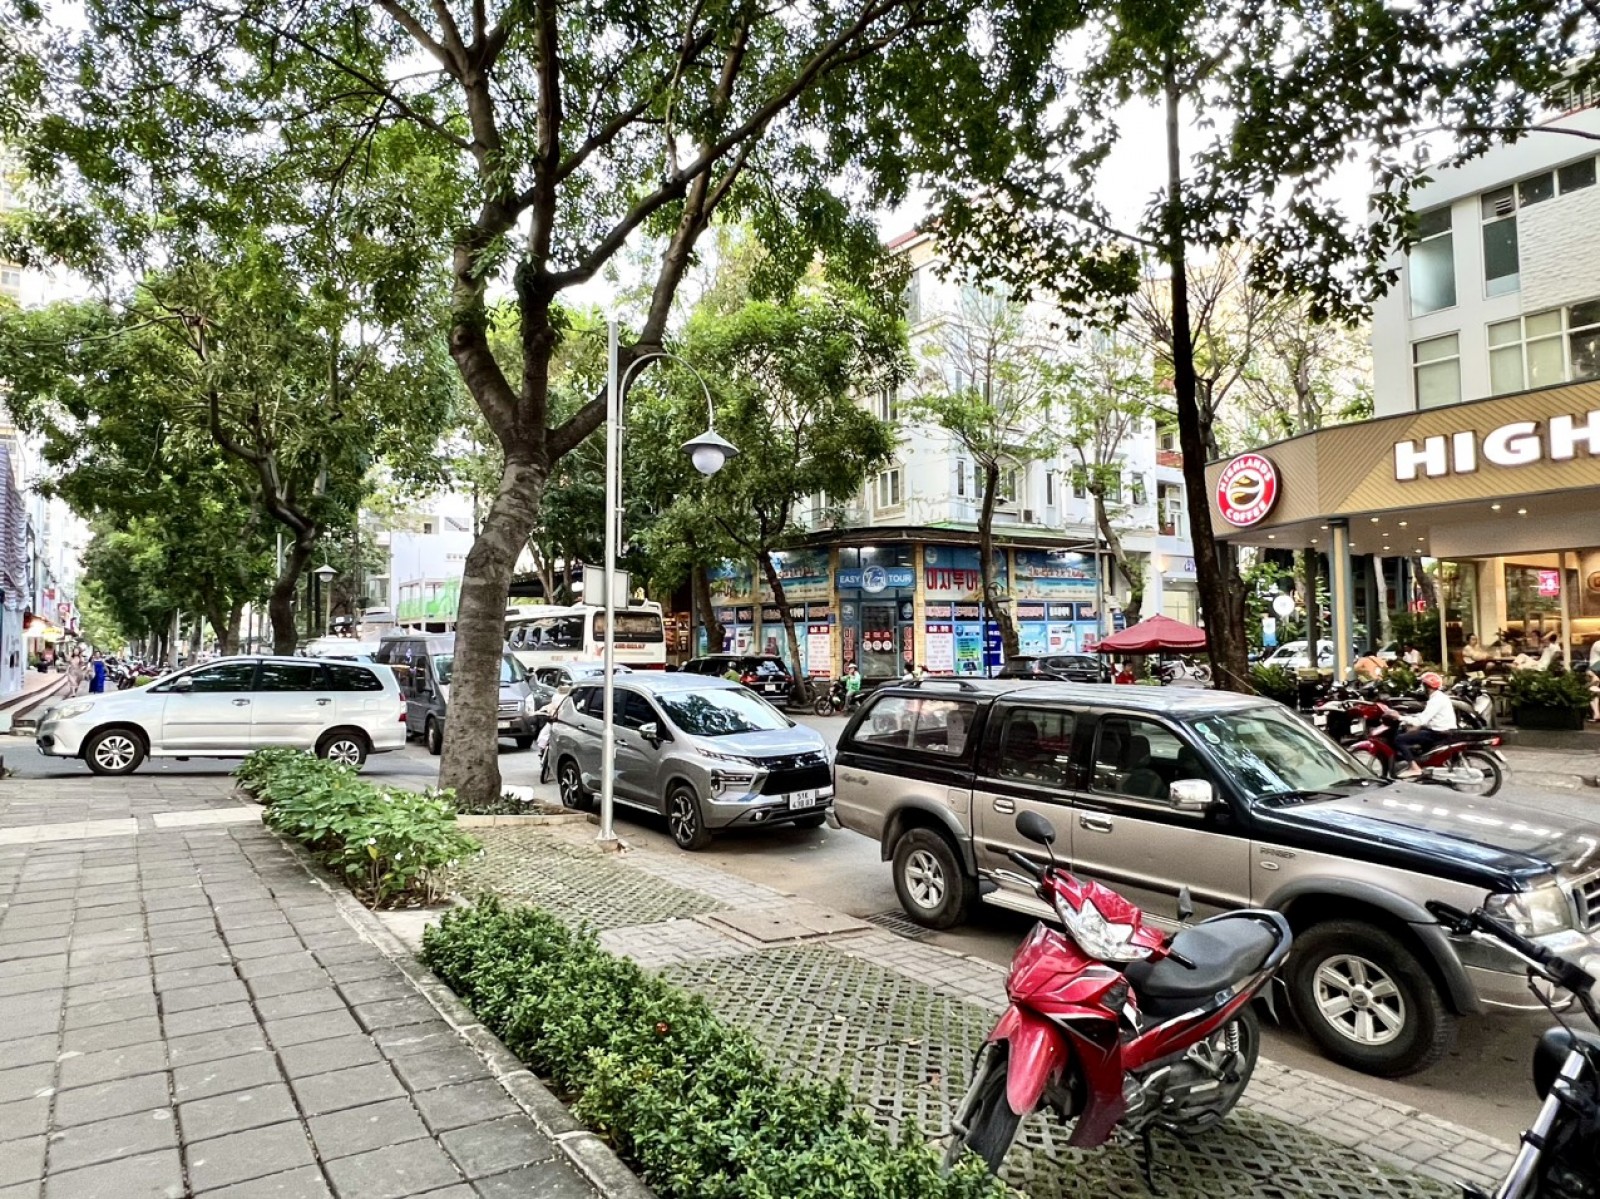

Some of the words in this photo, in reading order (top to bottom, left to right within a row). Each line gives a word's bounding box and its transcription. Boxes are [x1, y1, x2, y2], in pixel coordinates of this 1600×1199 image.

[1394, 410, 1600, 481] HIGH
[1219, 458, 1272, 492] HIGHLANDS
[1225, 500, 1267, 522] COFFEE
[839, 575, 861, 583] EASY
[888, 574, 913, 583] TOUR
[1260, 846, 1296, 859] RANGER
